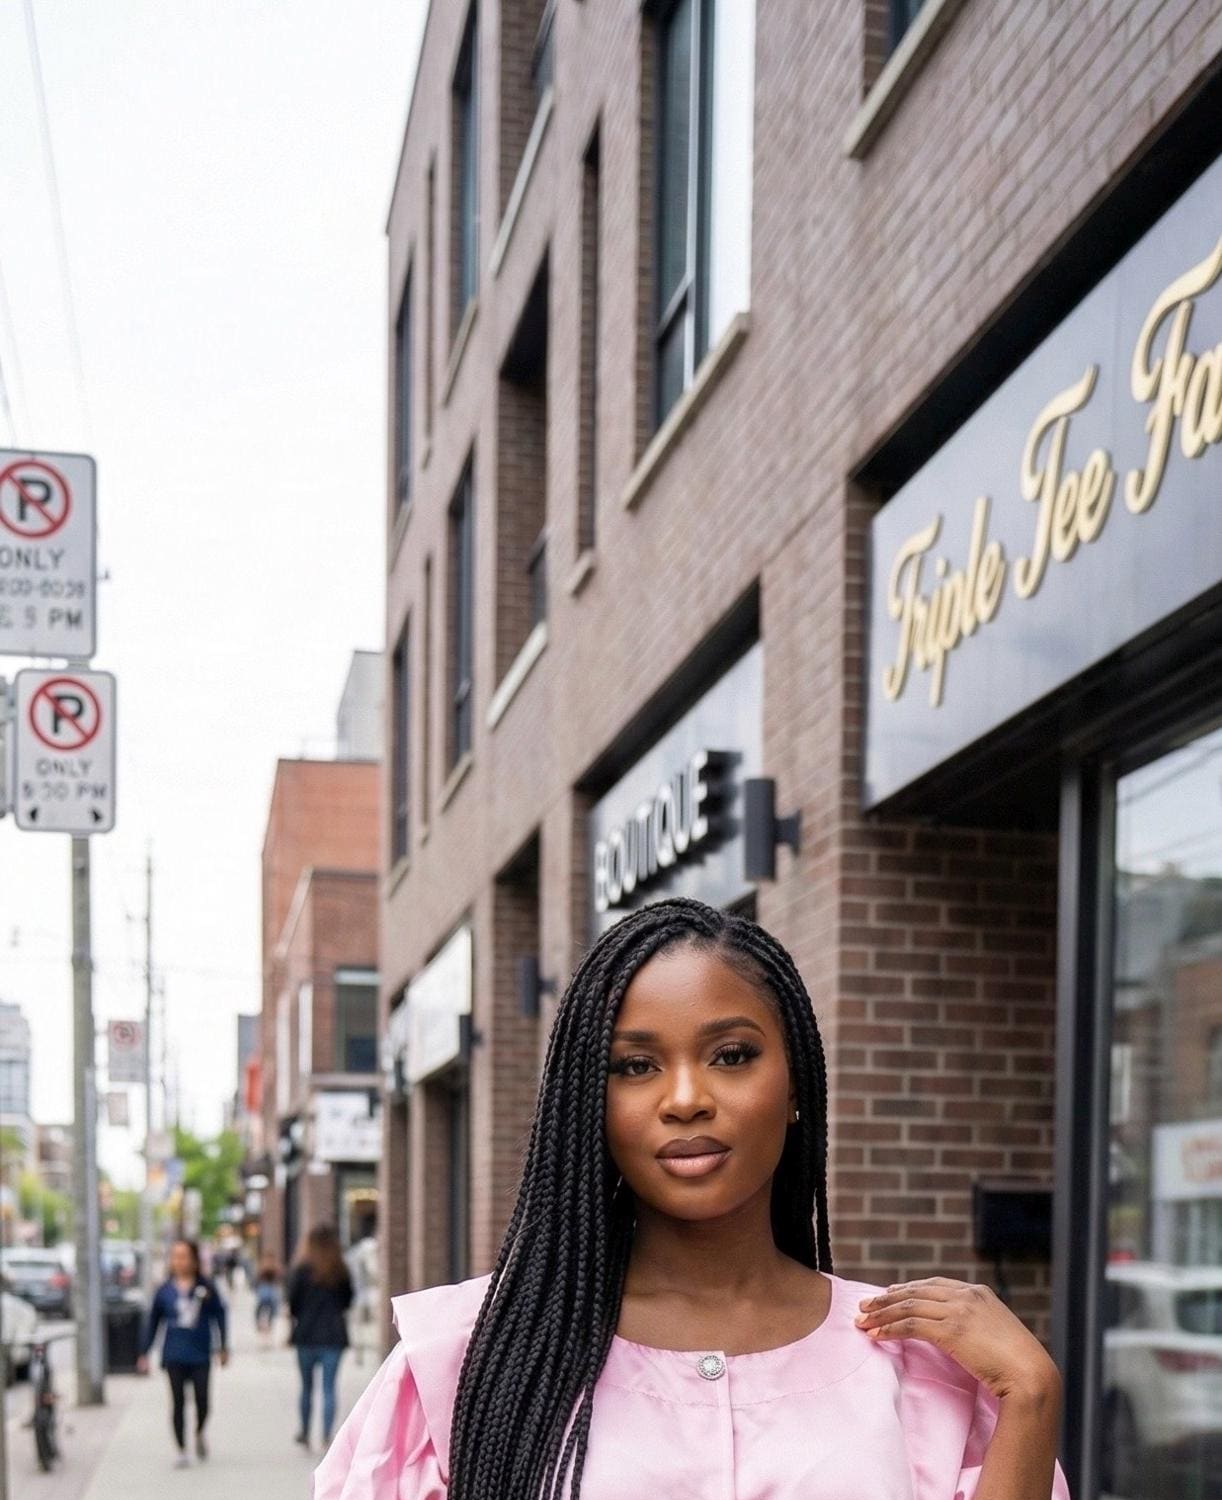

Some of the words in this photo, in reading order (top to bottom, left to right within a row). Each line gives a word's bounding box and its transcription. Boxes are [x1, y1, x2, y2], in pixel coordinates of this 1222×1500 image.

[884, 496, 1005, 708] Triple
[1014, 364, 1117, 601] Tee
[0, 546, 65, 571] ONLY
[48, 606, 82, 631] PM
[35, 758, 92, 779] ONLY
[77, 781, 108, 801] PM
[595, 749, 709, 912] BOUTIQUE
